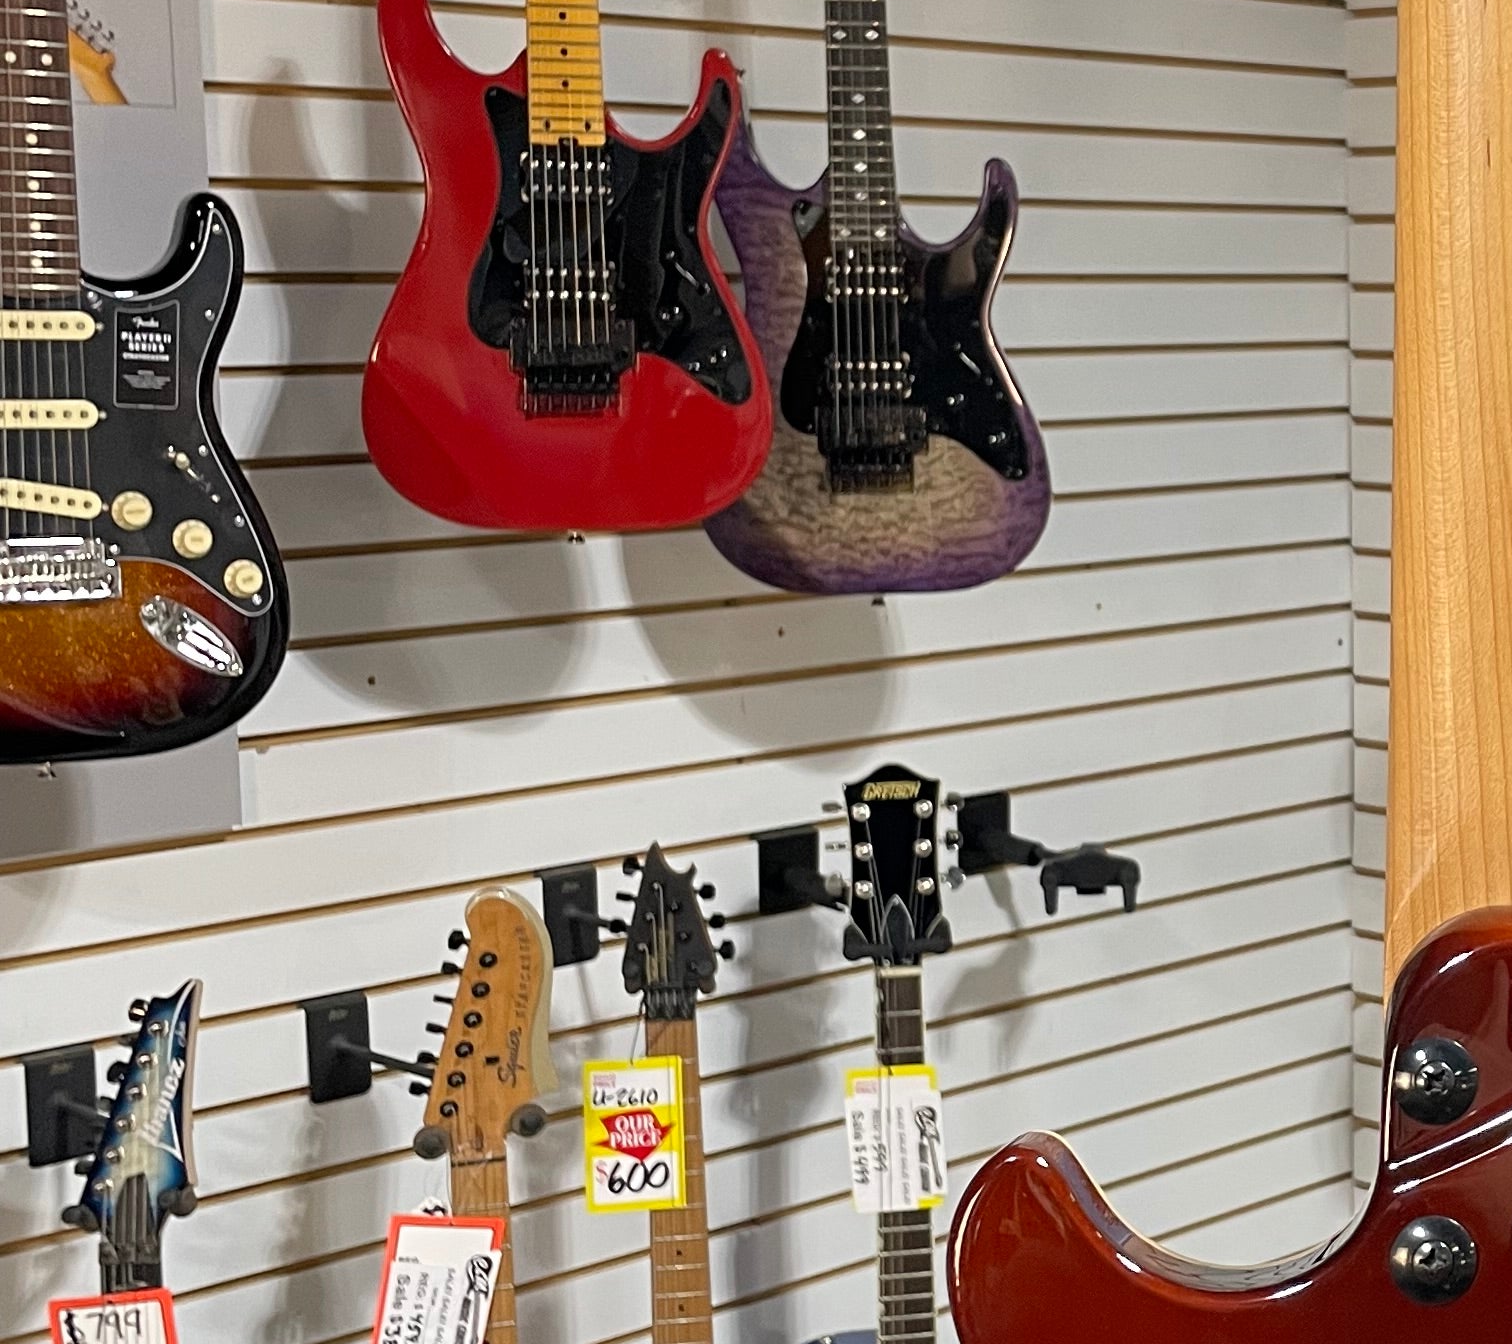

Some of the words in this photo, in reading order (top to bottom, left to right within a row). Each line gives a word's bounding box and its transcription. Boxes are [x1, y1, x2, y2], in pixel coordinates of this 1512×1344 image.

[614, 1113, 655, 1133] OUR
[609, 1128, 662, 1149] PRICE
[393, 1274, 411, 1311] Sale
